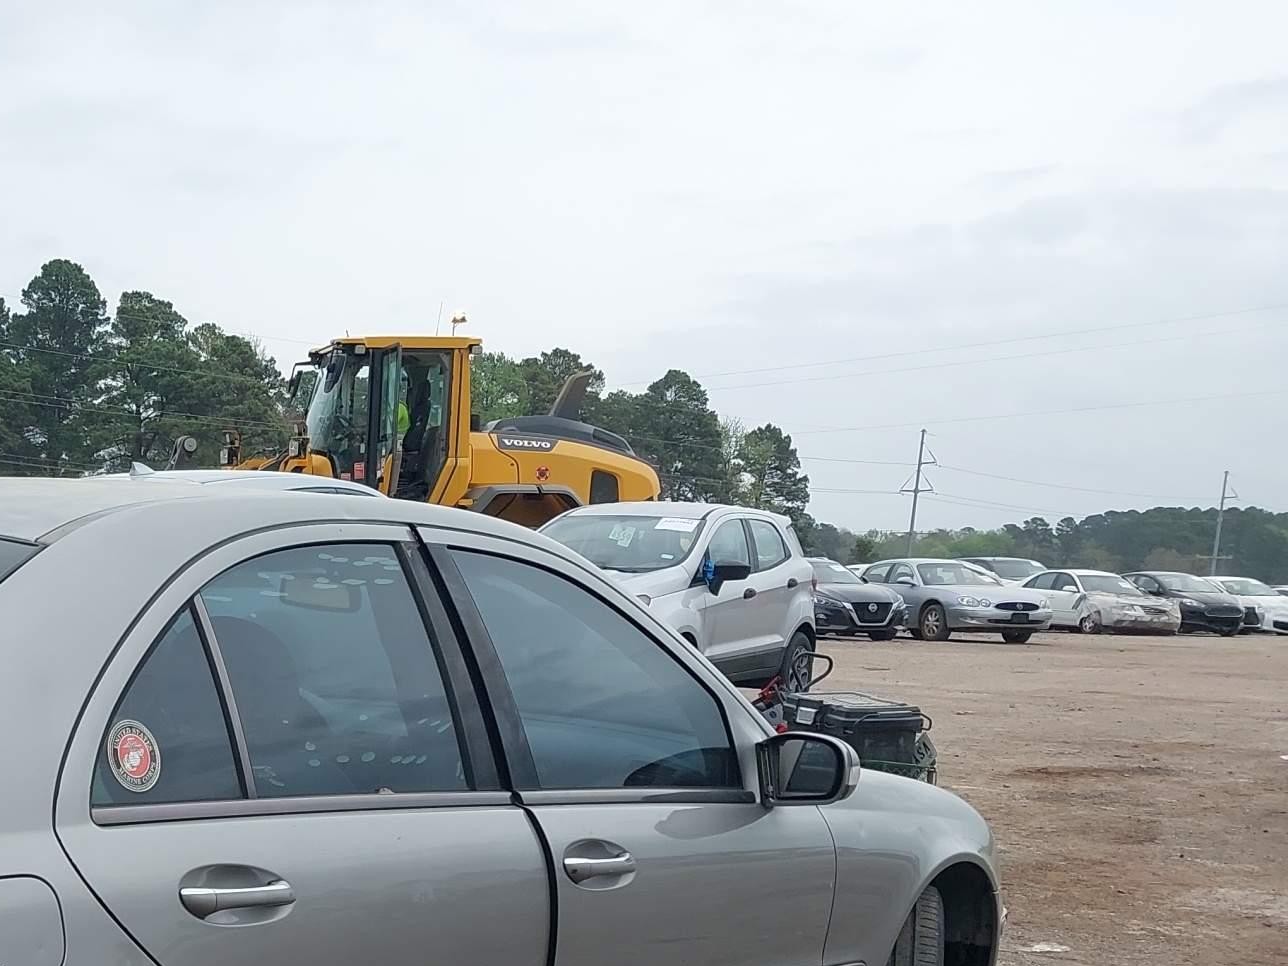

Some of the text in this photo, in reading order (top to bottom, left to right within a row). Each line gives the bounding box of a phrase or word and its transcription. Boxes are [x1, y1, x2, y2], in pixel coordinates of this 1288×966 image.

[502, 438, 551, 449] VOLVO
[114, 727, 153, 751] UNITED STATES
[118, 761, 157, 785] MARINE CORPS
